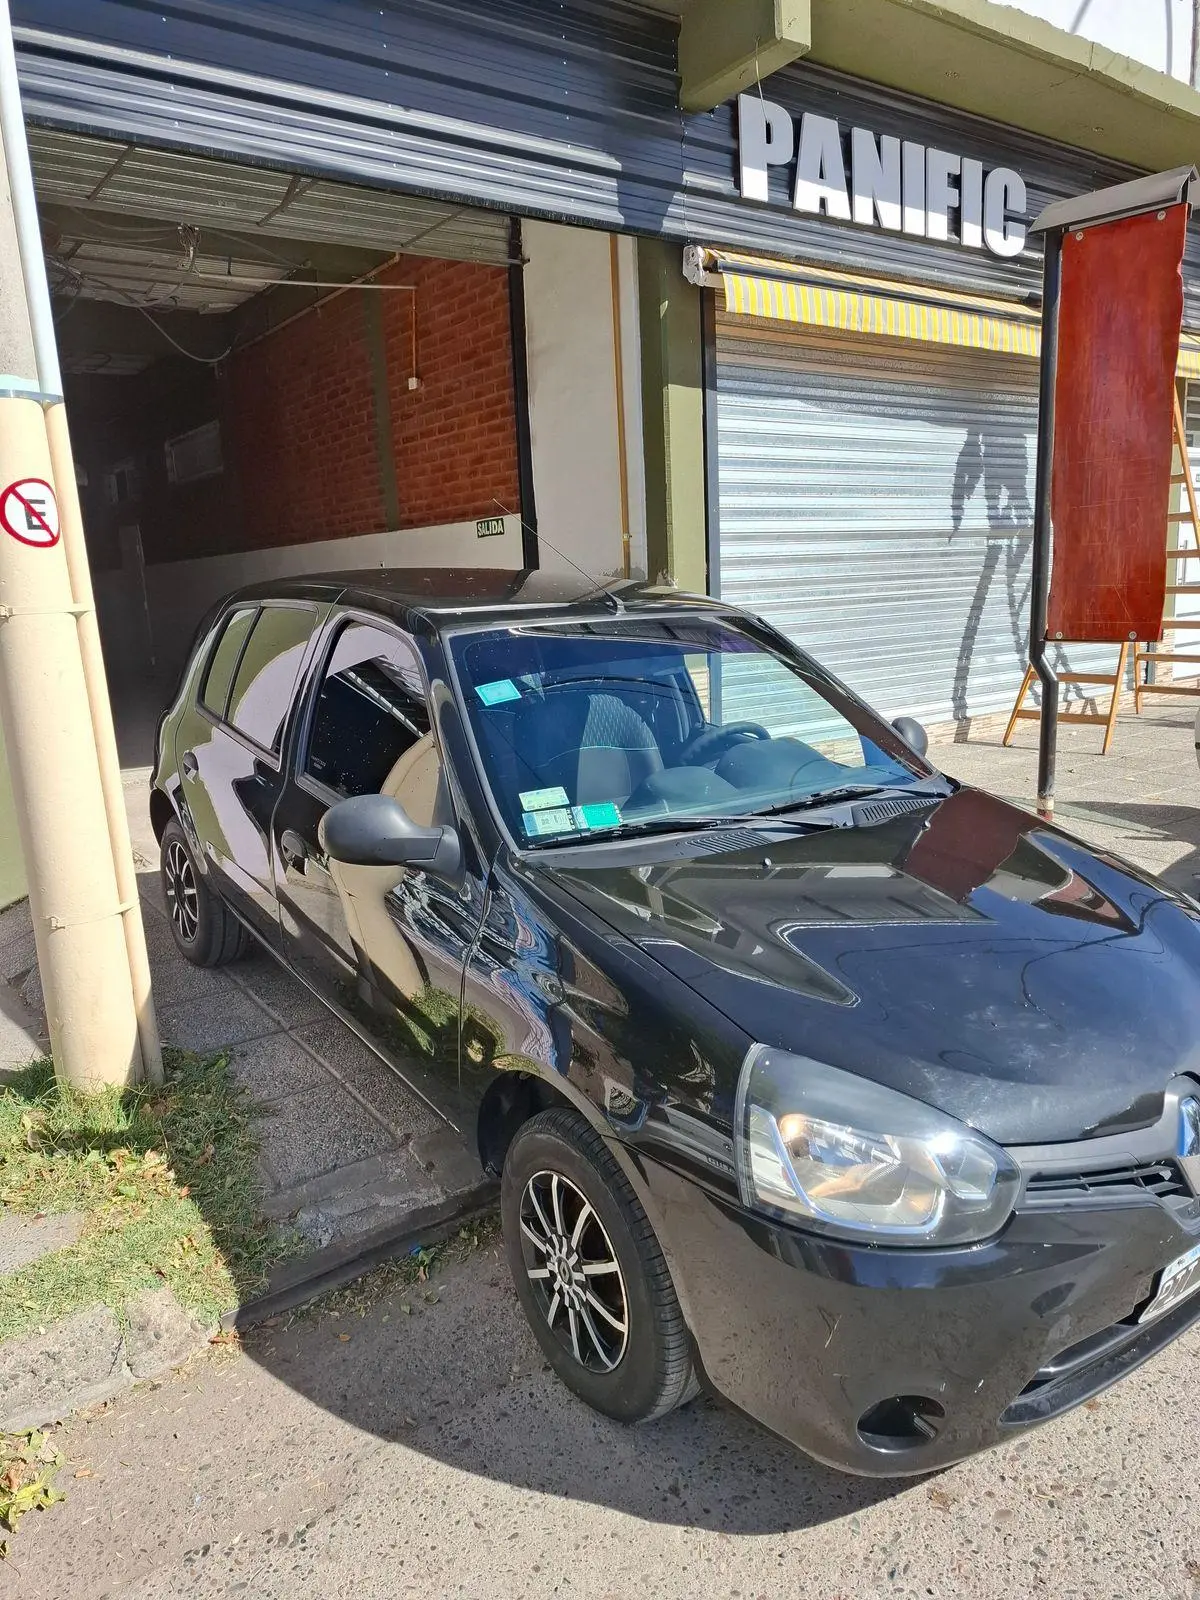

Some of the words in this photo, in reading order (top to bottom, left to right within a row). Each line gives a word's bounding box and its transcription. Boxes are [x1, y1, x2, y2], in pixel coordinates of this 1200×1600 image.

[738, 93, 1027, 257] PANIFIC
[24, 498, 49, 530] E
[477, 519, 504, 537] SALIDA
